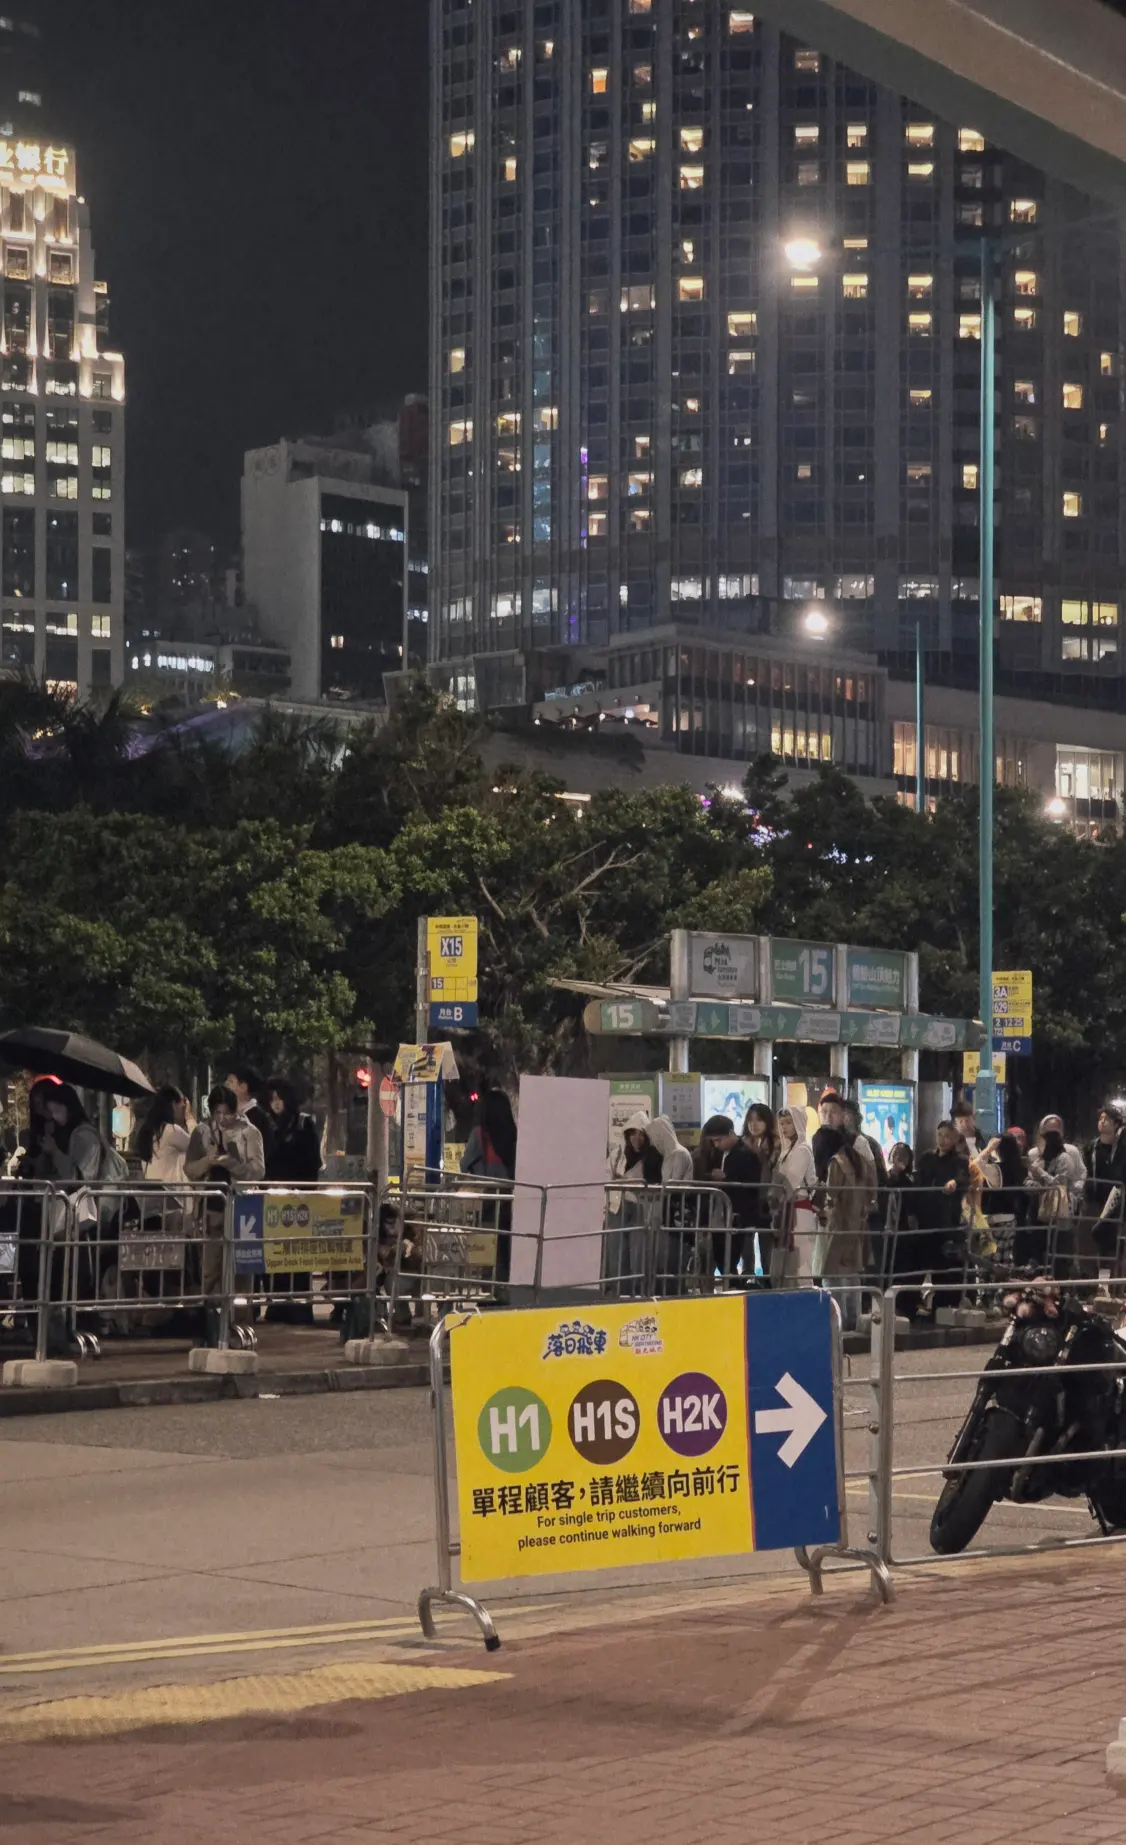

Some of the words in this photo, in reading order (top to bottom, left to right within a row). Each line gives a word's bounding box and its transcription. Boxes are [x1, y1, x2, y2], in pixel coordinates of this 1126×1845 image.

[441, 936, 462, 956] X15
[798, 948, 828, 994] 15
[432, 978, 443, 989] 15
[994, 986, 1008, 998] 3A
[454, 1006, 463, 1021] B
[607, 1003, 634, 1029] 15
[994, 1001, 1008, 1013] 629
[995, 1018, 1001, 1026] 2
[1005, 1018, 1013, 1026] 12
[1013, 1040, 1021, 1052] C
[543, 1329, 607, 1359] 落日飛車
[489, 1403, 541, 1454] H1
[573, 1398, 636, 1443] H1S
[662, 1393, 723, 1434] H2K
[537, 1515, 556, 1528] For
[559, 1511, 593, 1527] single
[596, 1509, 615, 1524] trip
[618, 1504, 681, 1520] customers,
[518, 1535, 556, 1552] please
[559, 1530, 608, 1545] continue
[612, 1523, 655, 1538] walking
[658, 1517, 701, 1534] forward
